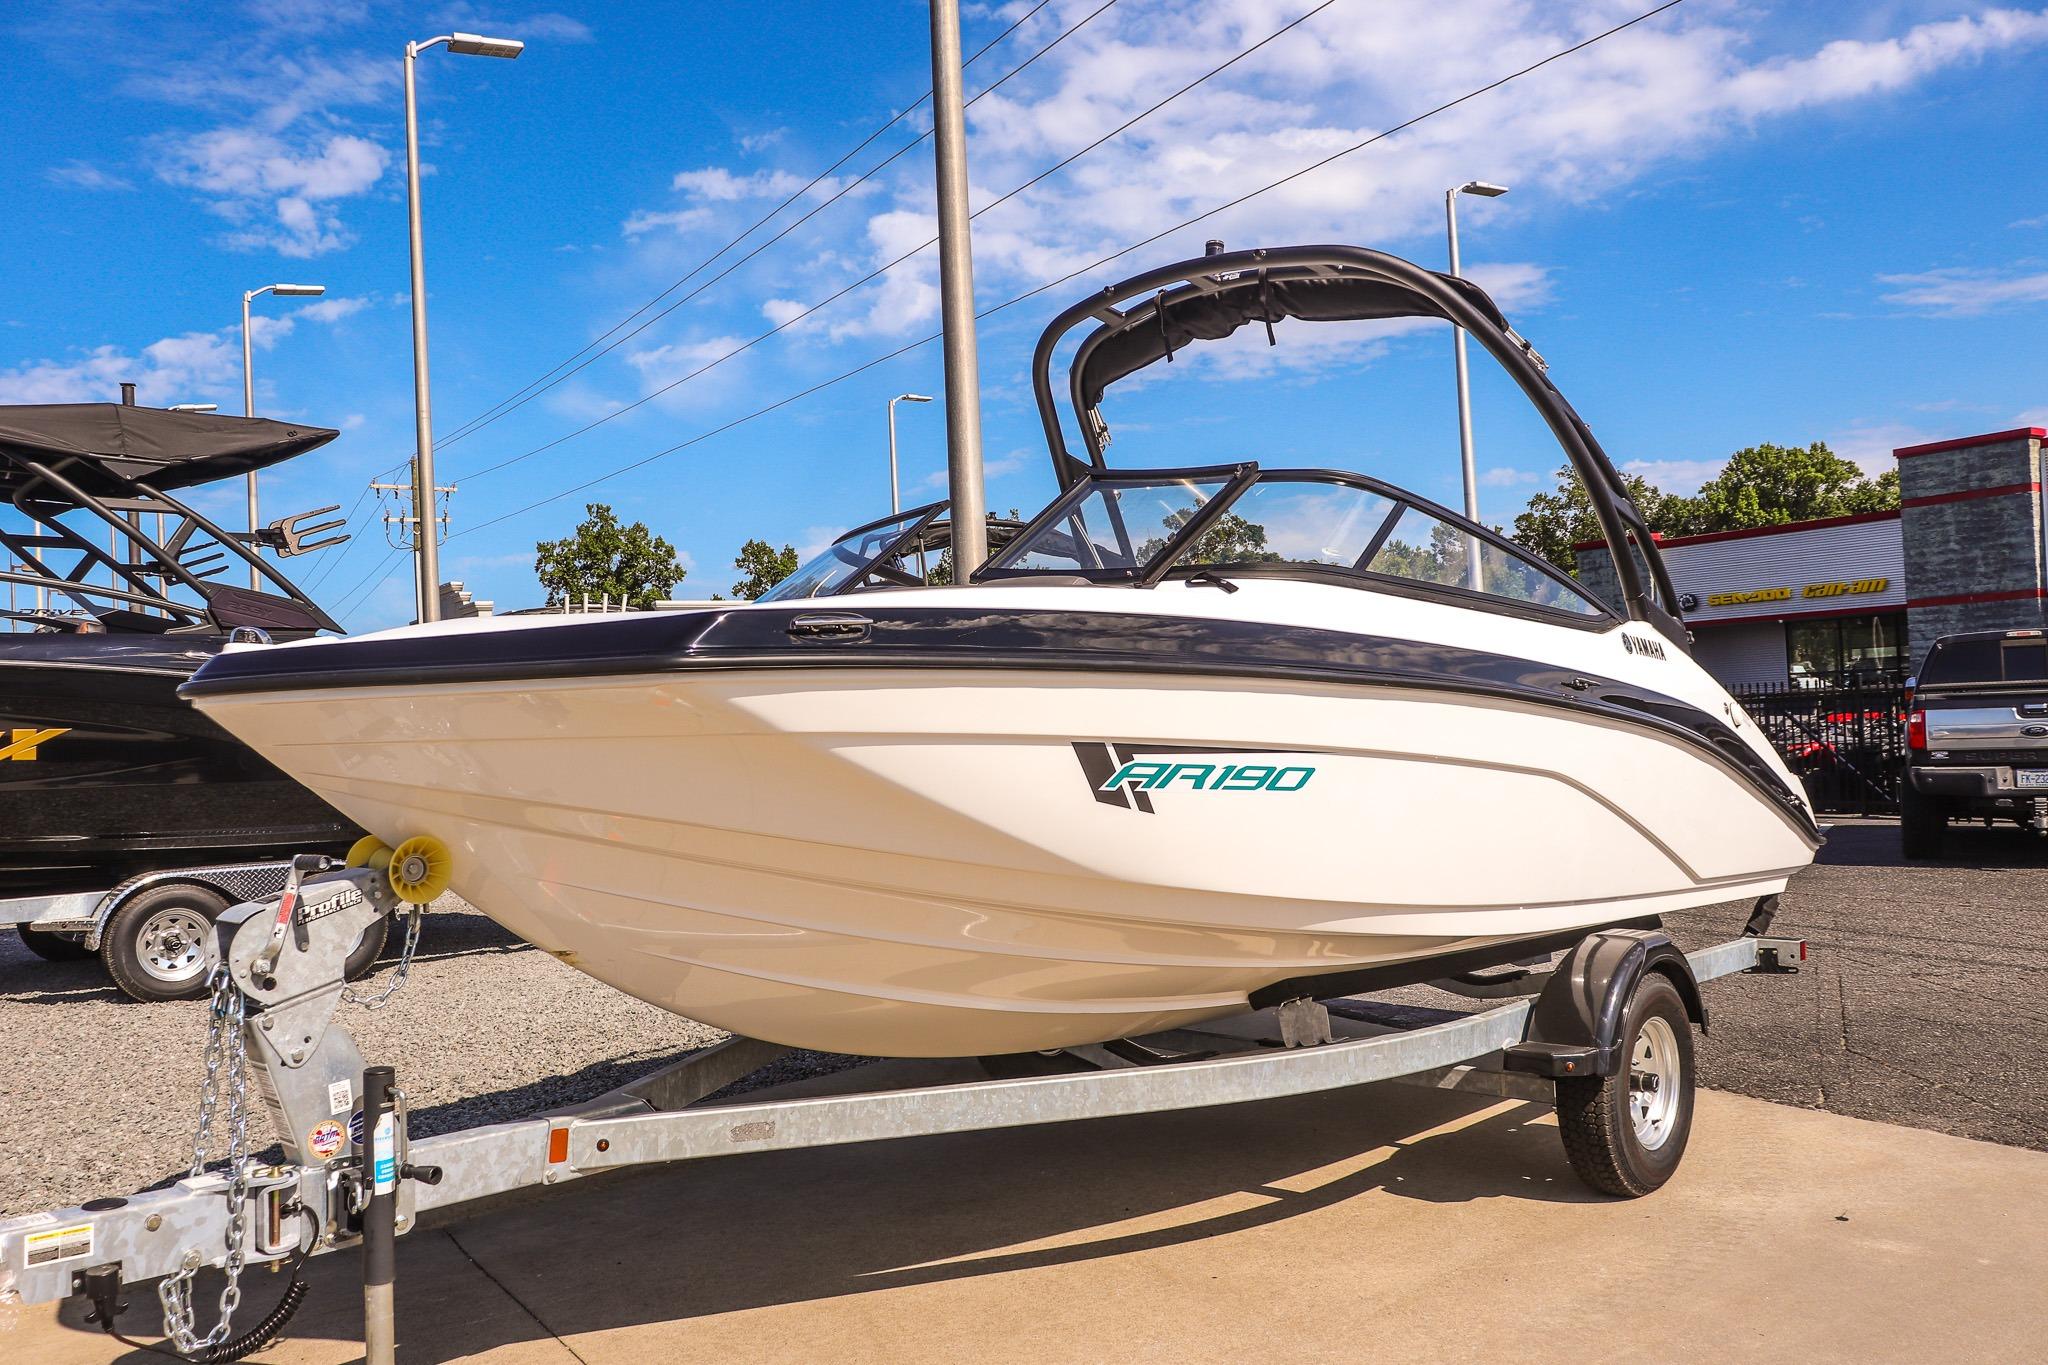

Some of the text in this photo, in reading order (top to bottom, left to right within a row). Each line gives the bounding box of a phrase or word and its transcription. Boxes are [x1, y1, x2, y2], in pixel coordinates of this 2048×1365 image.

[1630, 635, 1666, 661] YAMAHA
[1105, 762, 1316, 791] AR190
[298, 889, 362, 920] Profile
